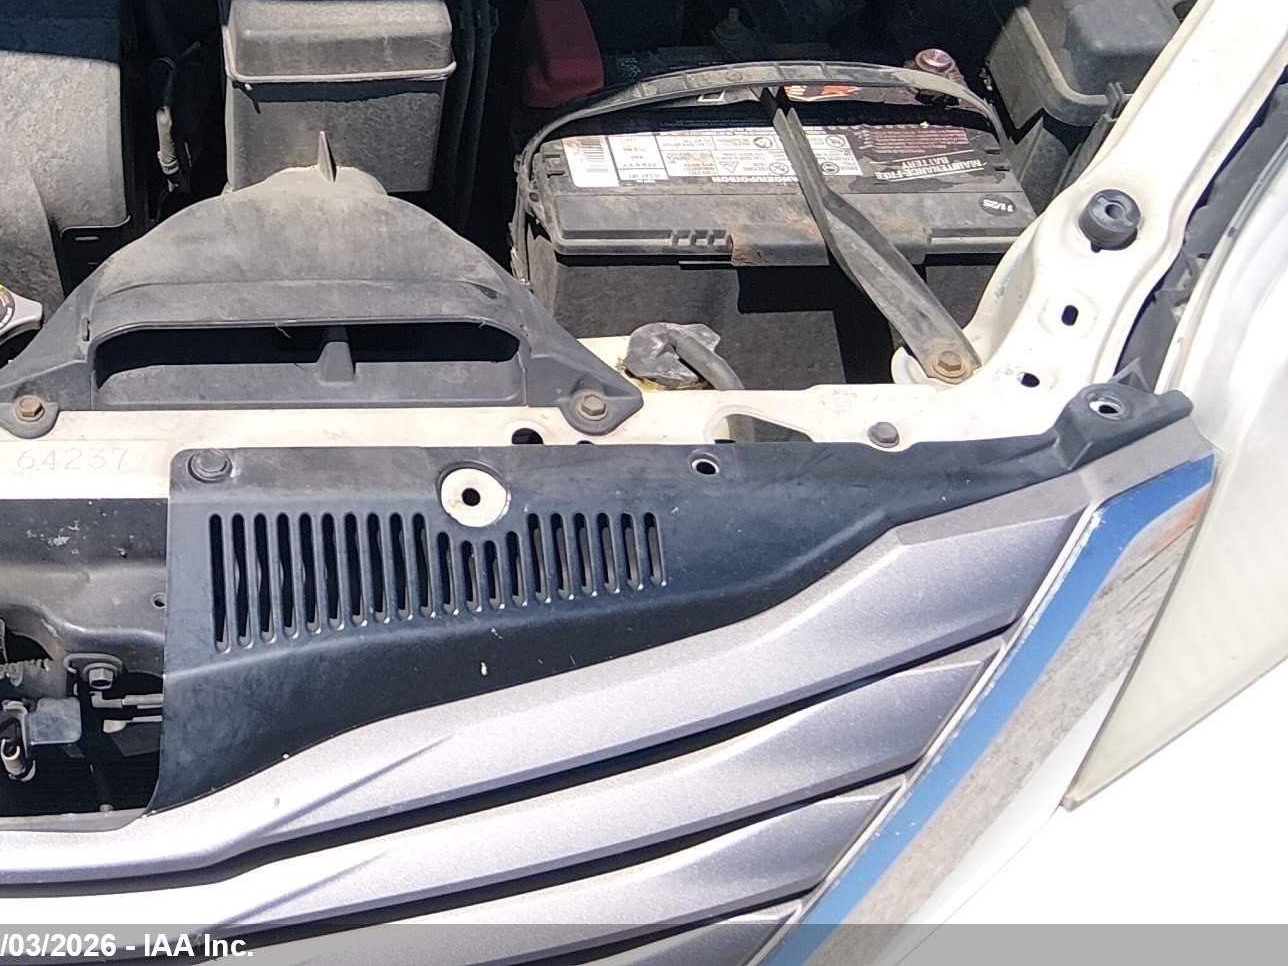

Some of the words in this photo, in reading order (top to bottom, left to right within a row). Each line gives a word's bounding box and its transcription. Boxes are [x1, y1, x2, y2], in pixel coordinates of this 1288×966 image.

[874, 158, 983, 180] MAINTENANCE-FREE
[901, 156, 949, 170] BATTERY
[712, 175, 800, 183] ANGER/POISON
[982, 198, 1014, 212] 11/25
[16, 447, 129, 471] 64237
